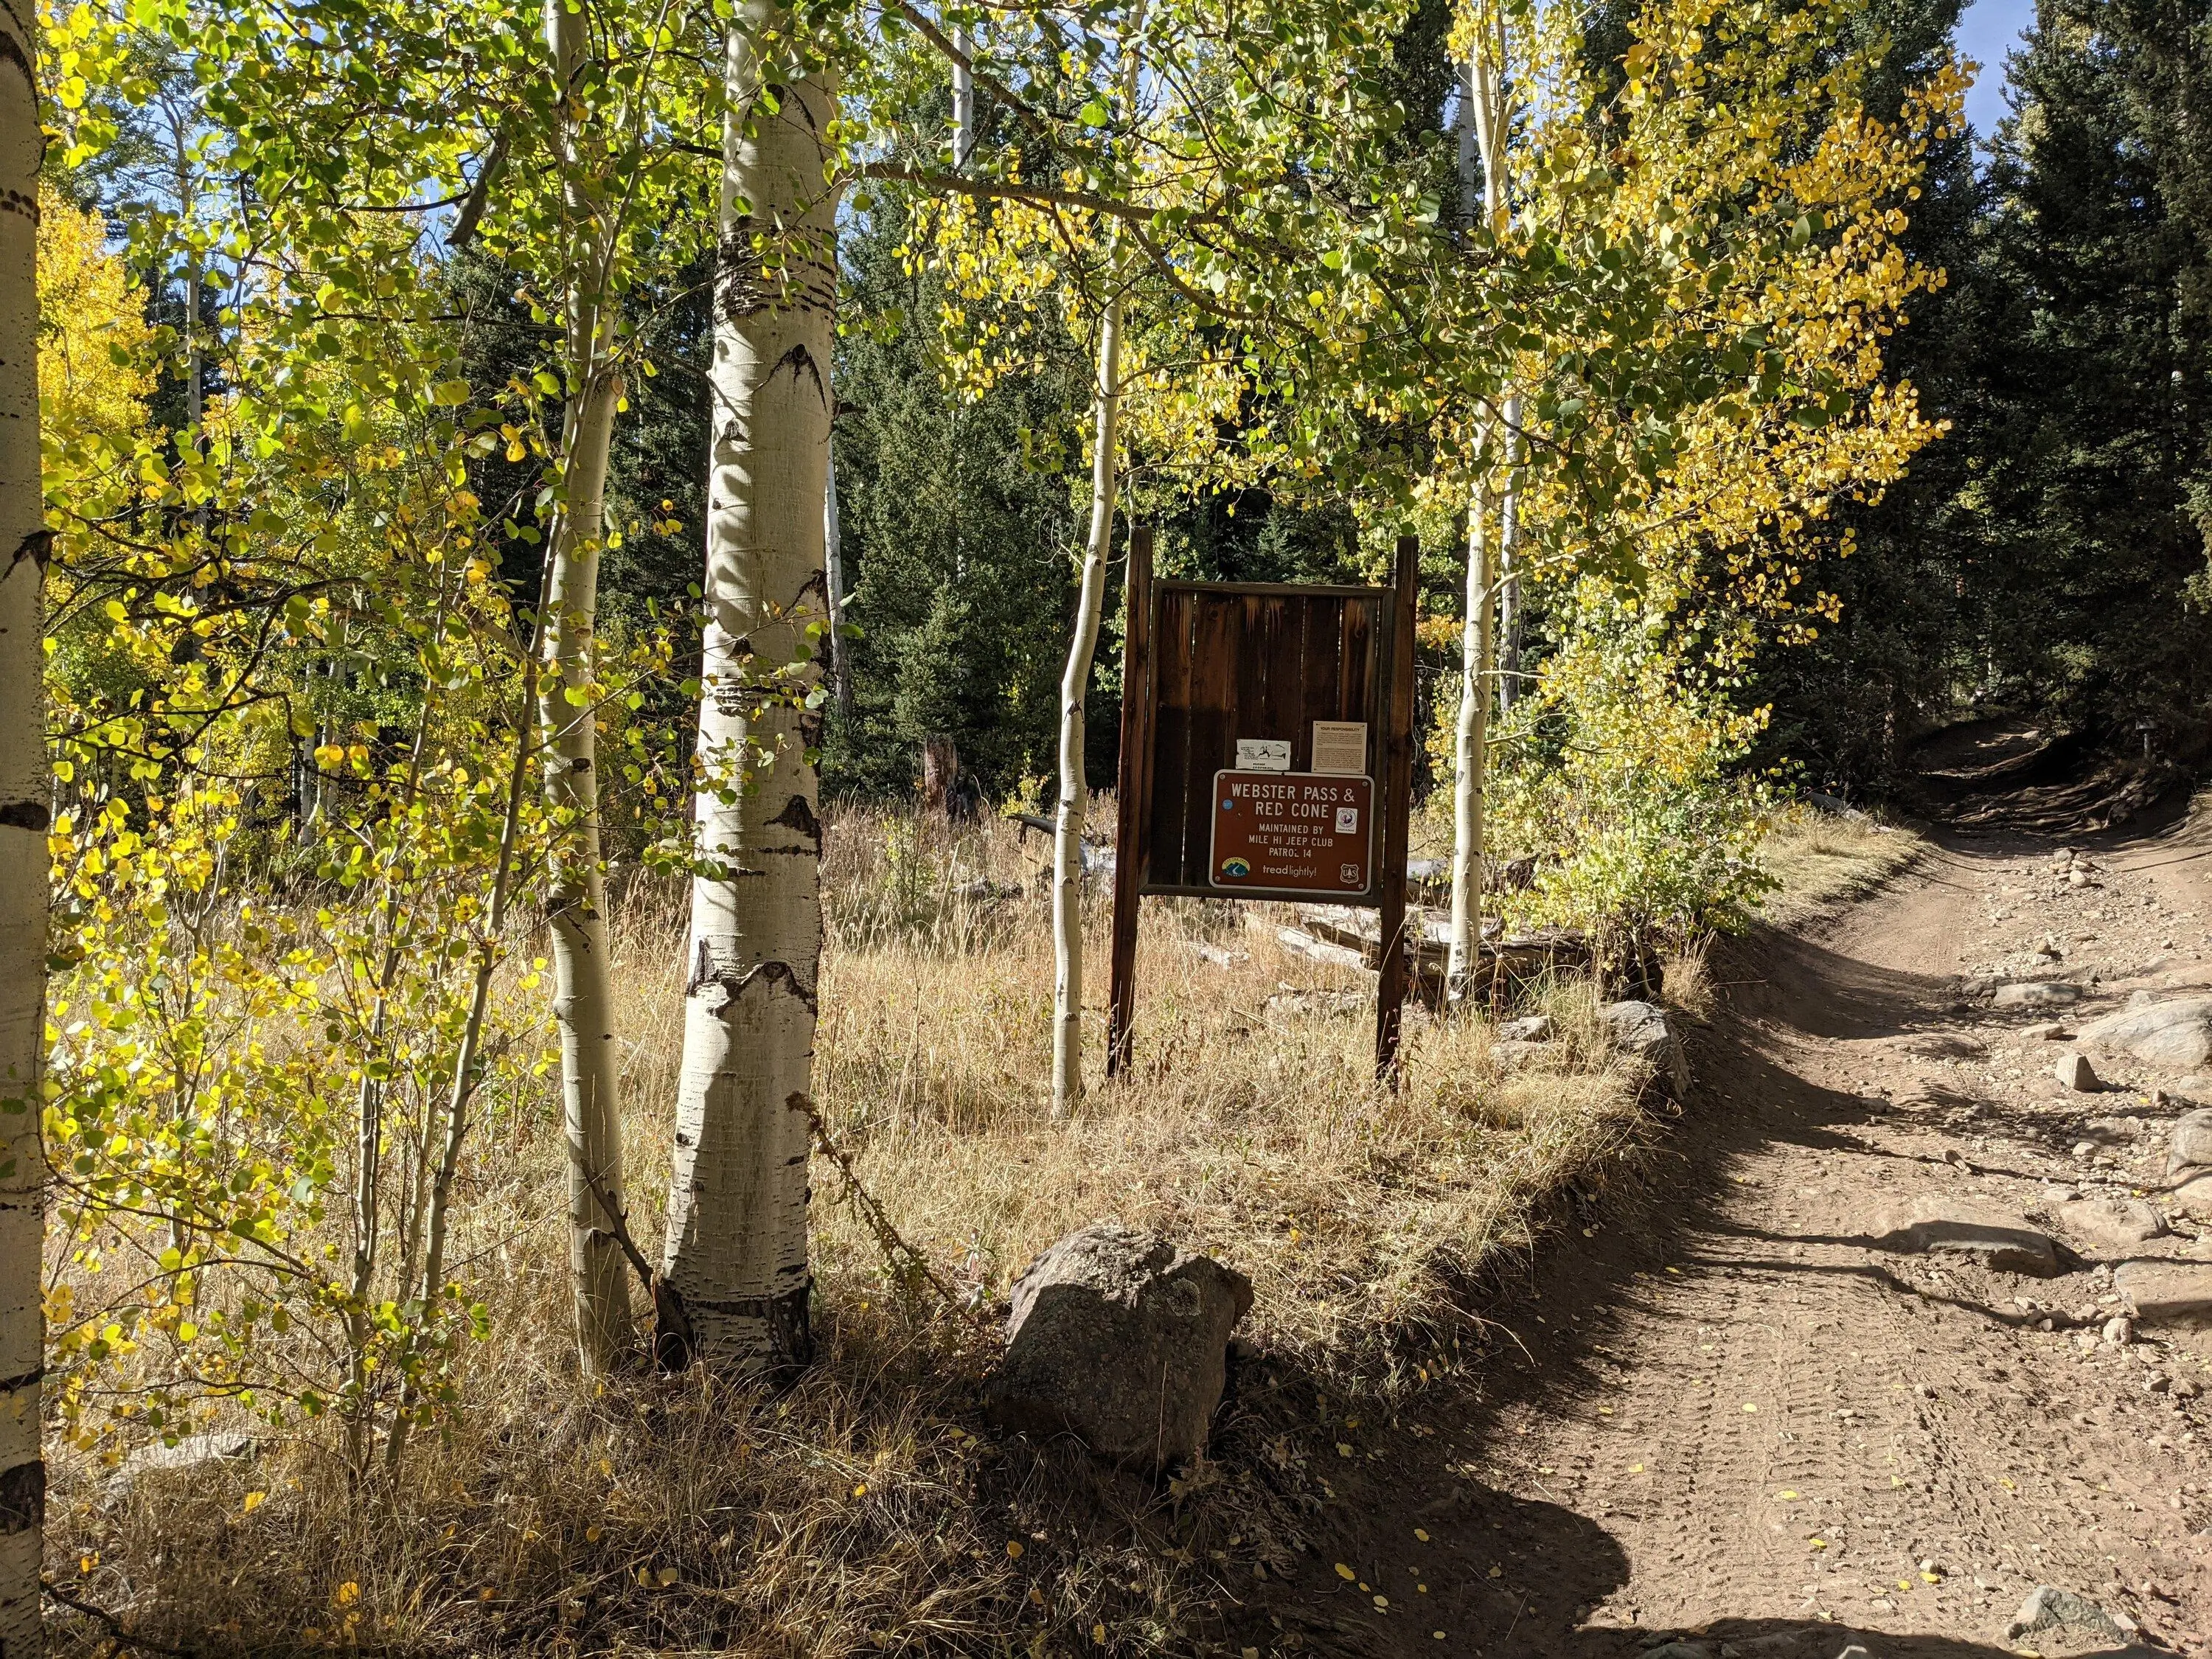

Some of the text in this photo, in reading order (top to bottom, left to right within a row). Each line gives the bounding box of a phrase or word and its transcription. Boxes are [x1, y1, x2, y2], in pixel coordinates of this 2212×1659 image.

[1231, 783, 1355, 802] WEBSTER PASS &
[1255, 801, 1283, 815] RED
[1291, 803, 1329, 818] CONE
[1259, 823, 1324, 835] MAINTAINED BY
[1248, 835, 1333, 847] MILE HI JEEP CLUB
[1269, 848, 1312, 858] PATROL 14
